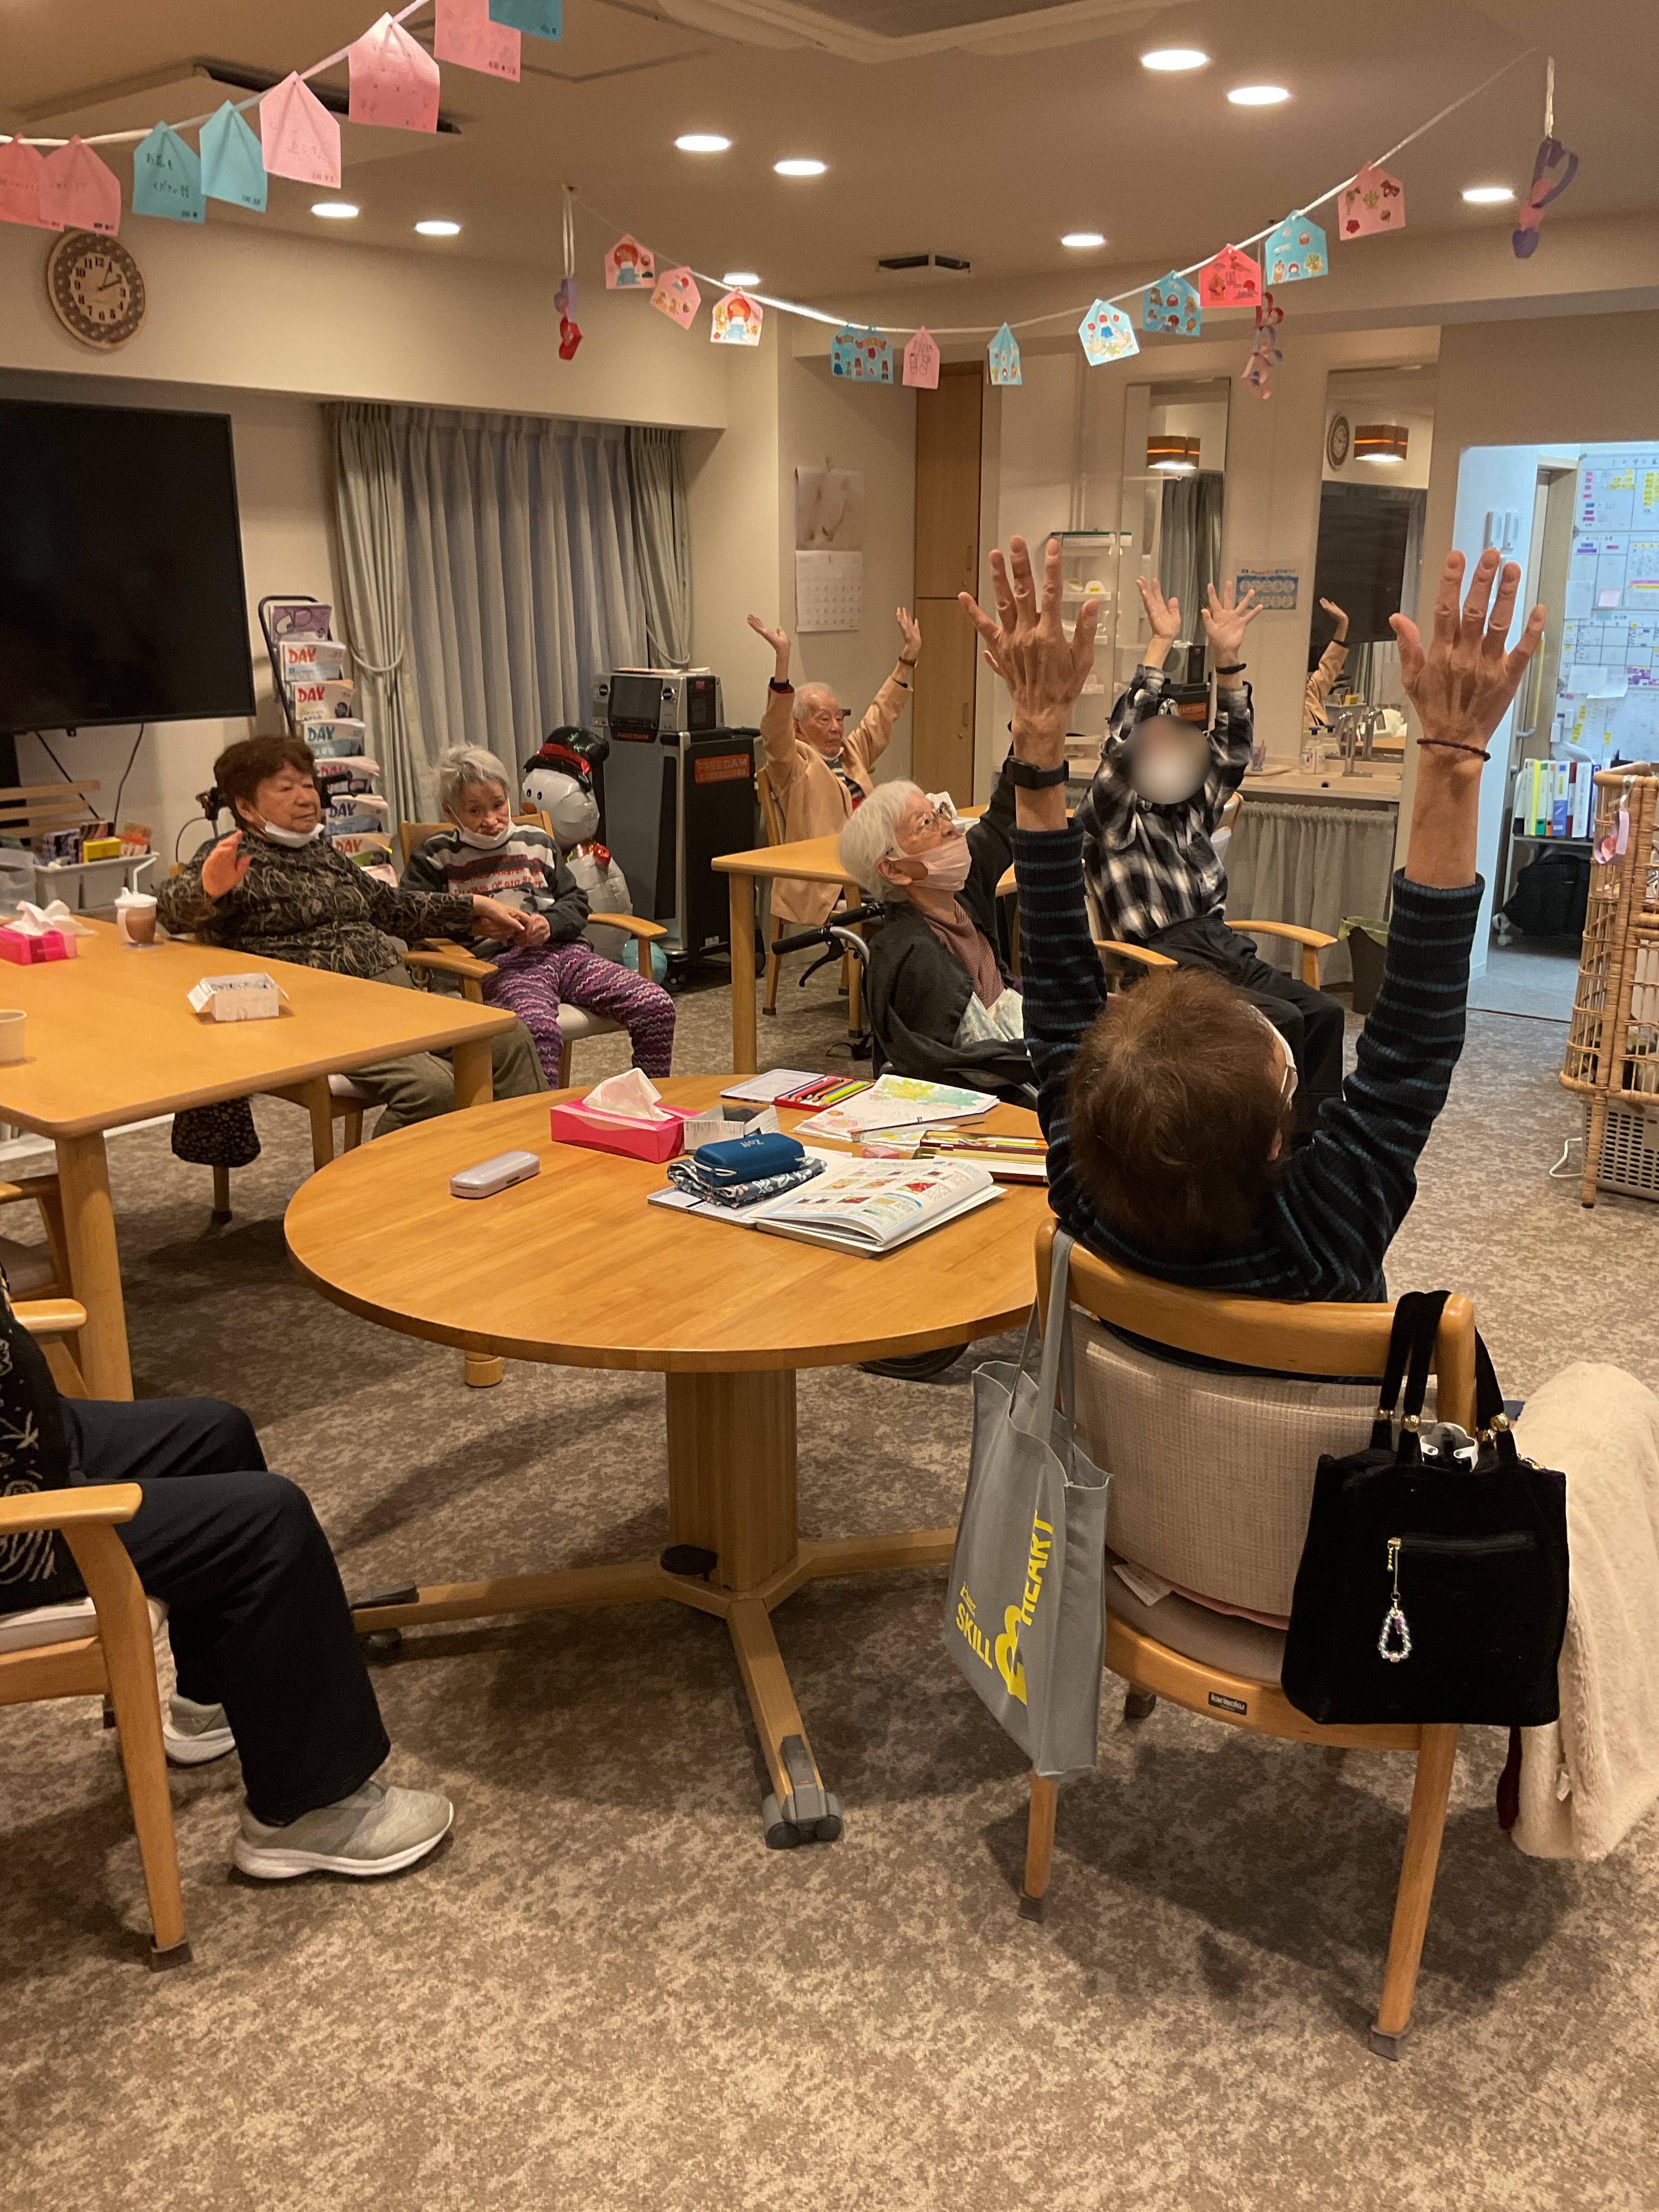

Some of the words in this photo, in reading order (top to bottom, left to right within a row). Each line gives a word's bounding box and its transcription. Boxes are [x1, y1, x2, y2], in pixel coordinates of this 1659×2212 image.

[84, 257, 92, 269] 11
[95, 256, 104, 267] 12
[76, 267, 86, 278] 10
[87, 306, 93, 315] 7
[288, 647, 317, 664] DAY
[297, 686, 325, 703] DAY
[307, 725, 335, 742] DAY
[724, 758, 747, 769] DAM
[329, 803, 357, 817] DAY
[335, 839, 363, 854] DAY
[740, 1138, 764, 1148] Zoff
[955, 1601, 993, 1670] SKILL
